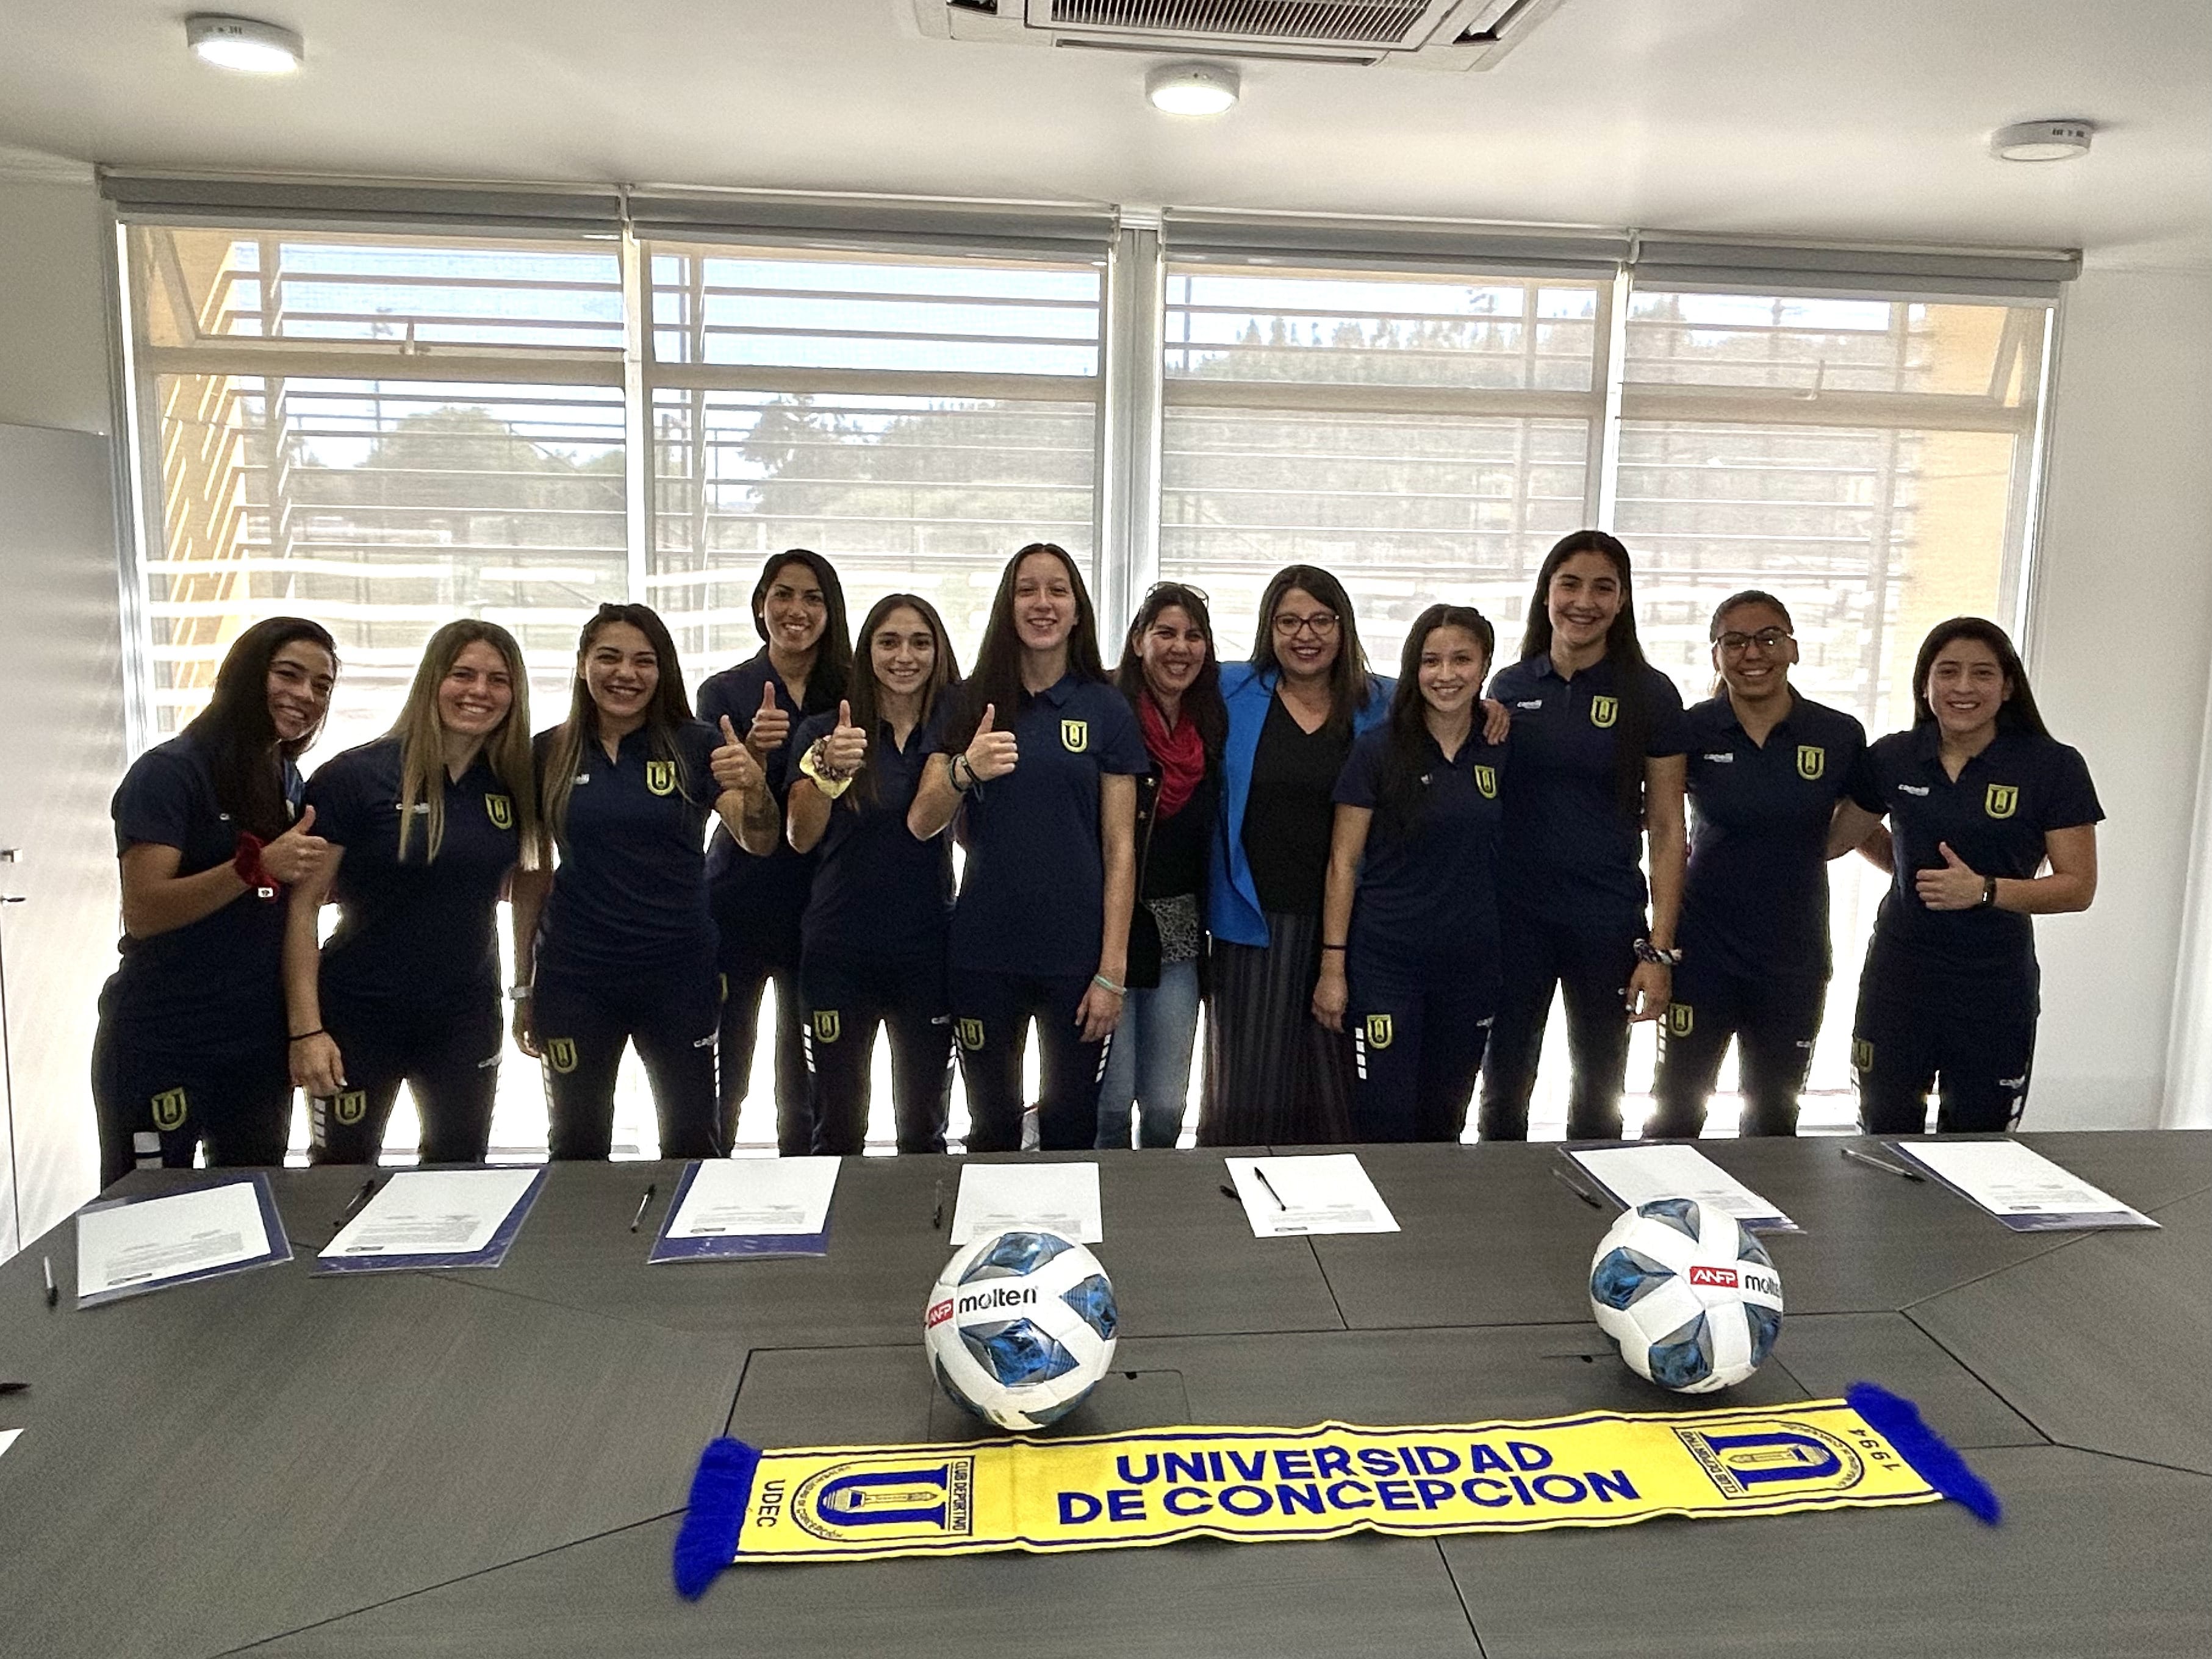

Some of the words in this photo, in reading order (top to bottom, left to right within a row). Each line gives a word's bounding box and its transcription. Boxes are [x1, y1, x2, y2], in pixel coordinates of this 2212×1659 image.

[1692, 1269, 1736, 1285] ANFP
[958, 1288, 1037, 1314] molten
[1116, 1441, 1554, 1485] UNIVERSIDAD
[1847, 1428, 1901, 1471] 1994
[756, 1478, 786, 1527] UDEC
[1057, 1489, 1147, 1525] DE
[1162, 1469, 1642, 1517] CONCEPCION
